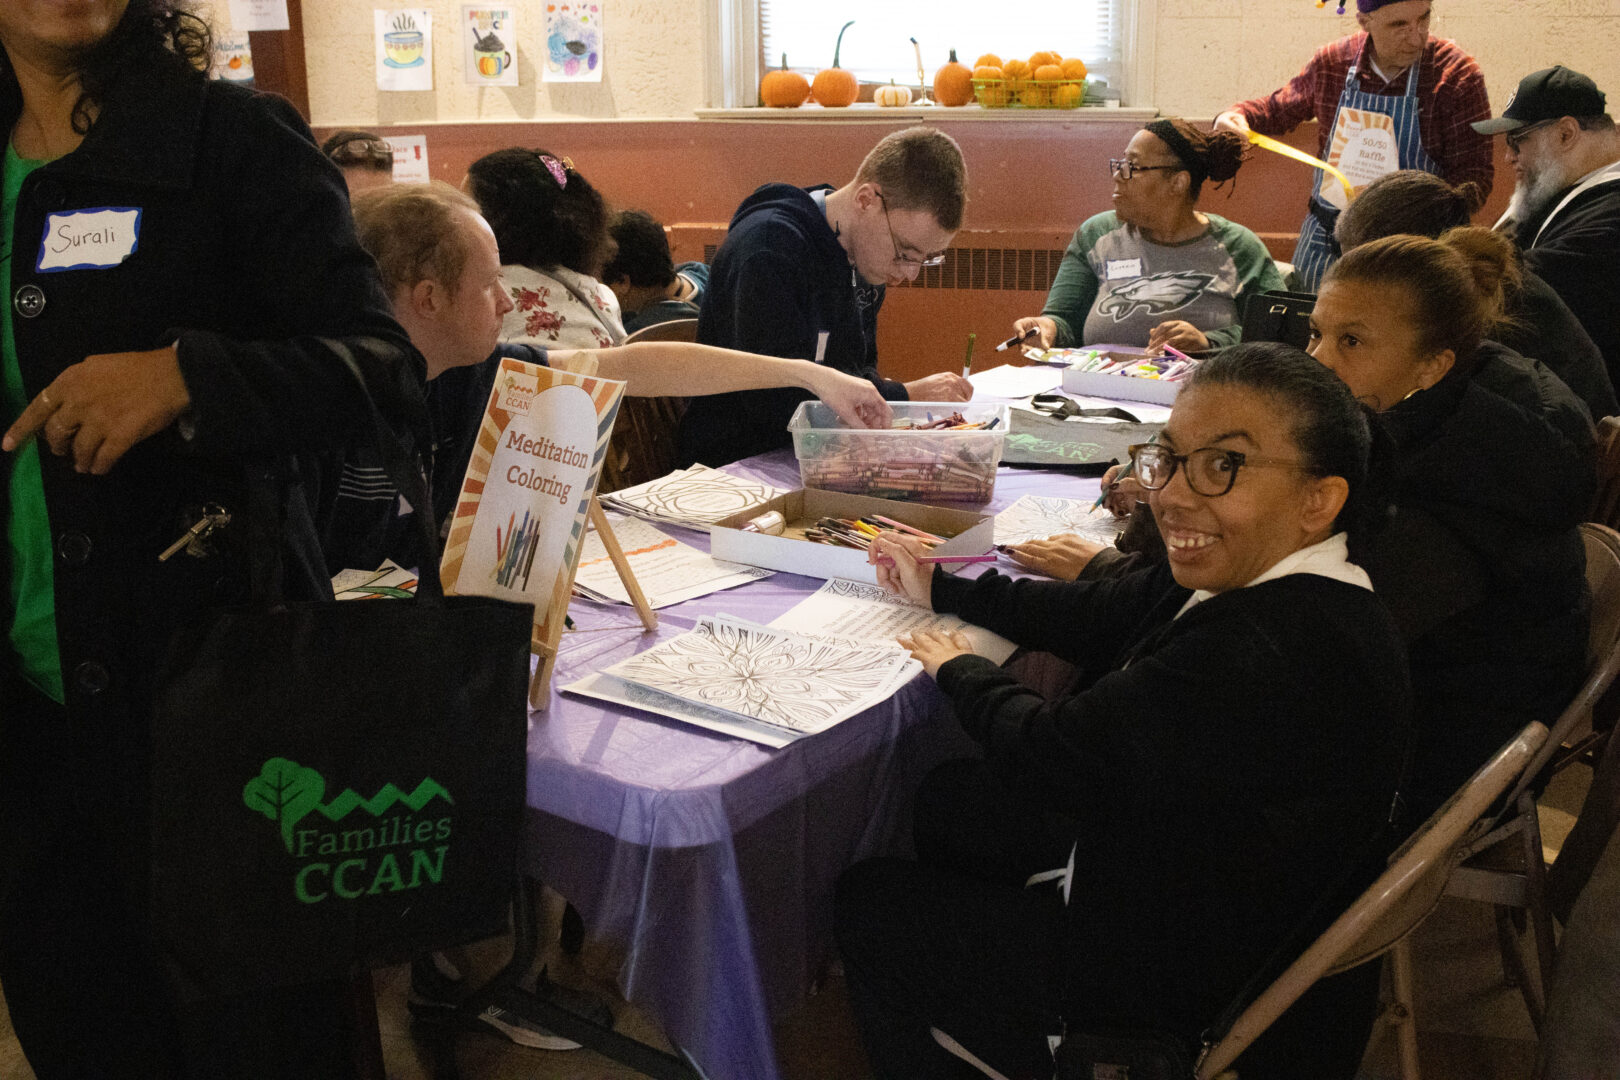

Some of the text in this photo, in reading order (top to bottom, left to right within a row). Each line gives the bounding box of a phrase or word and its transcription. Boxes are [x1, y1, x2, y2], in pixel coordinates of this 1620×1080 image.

[1359, 149, 1386, 162] Raffle
[1362, 137, 1388, 150] 50/50
[51, 224, 115, 253] Surali
[505, 397, 530, 410] CCAN
[505, 430, 589, 469] Meditation
[506, 465, 572, 505] Coloring
[296, 815, 451, 858] Families
[295, 845, 449, 904] CCAN
